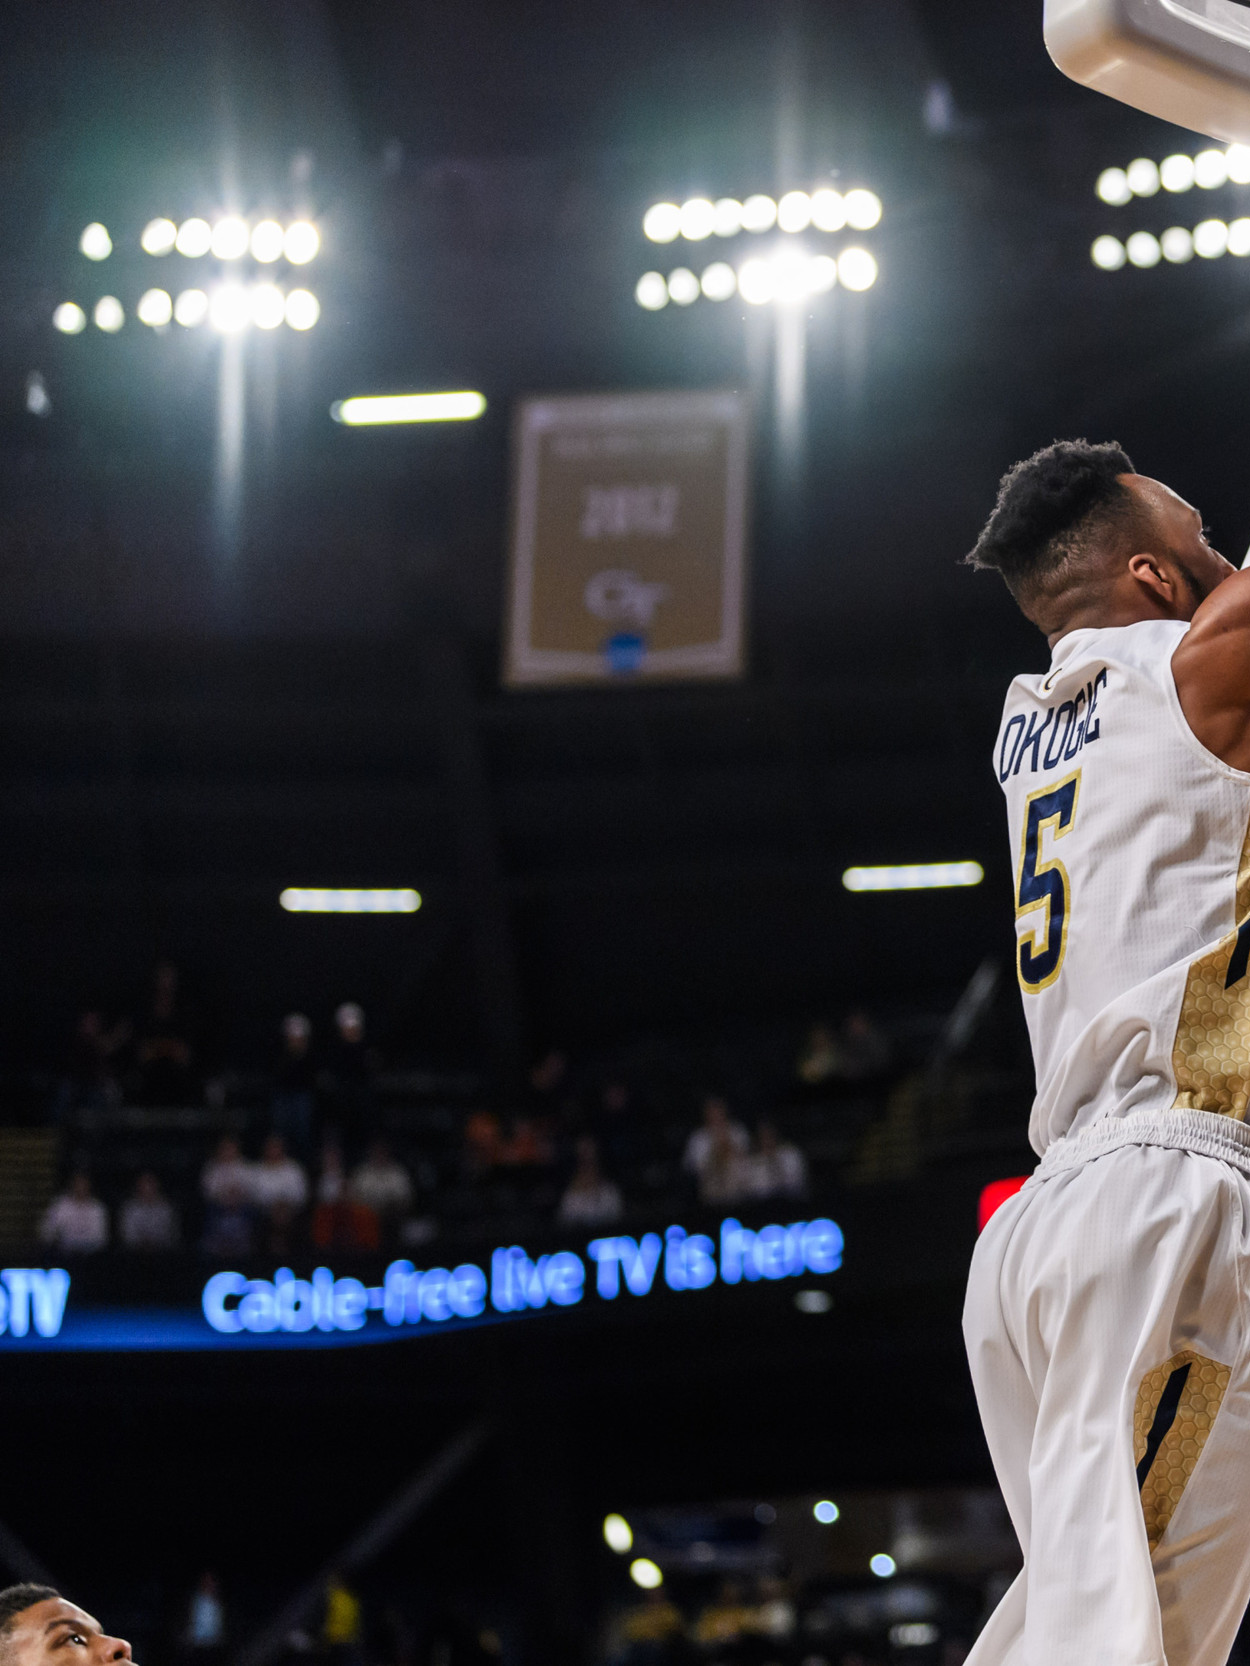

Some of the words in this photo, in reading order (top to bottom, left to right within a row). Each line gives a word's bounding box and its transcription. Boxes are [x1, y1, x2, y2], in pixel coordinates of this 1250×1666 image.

[1000, 667, 1108, 783] OKOGIE
[1015, 767, 1082, 994] 5
[202, 1259, 488, 1333] Cable-free
[491, 1245, 586, 1313] live
[587, 1232, 663, 1300] TV
[665, 1225, 717, 1291] is
[720, 1217, 844, 1285] here
